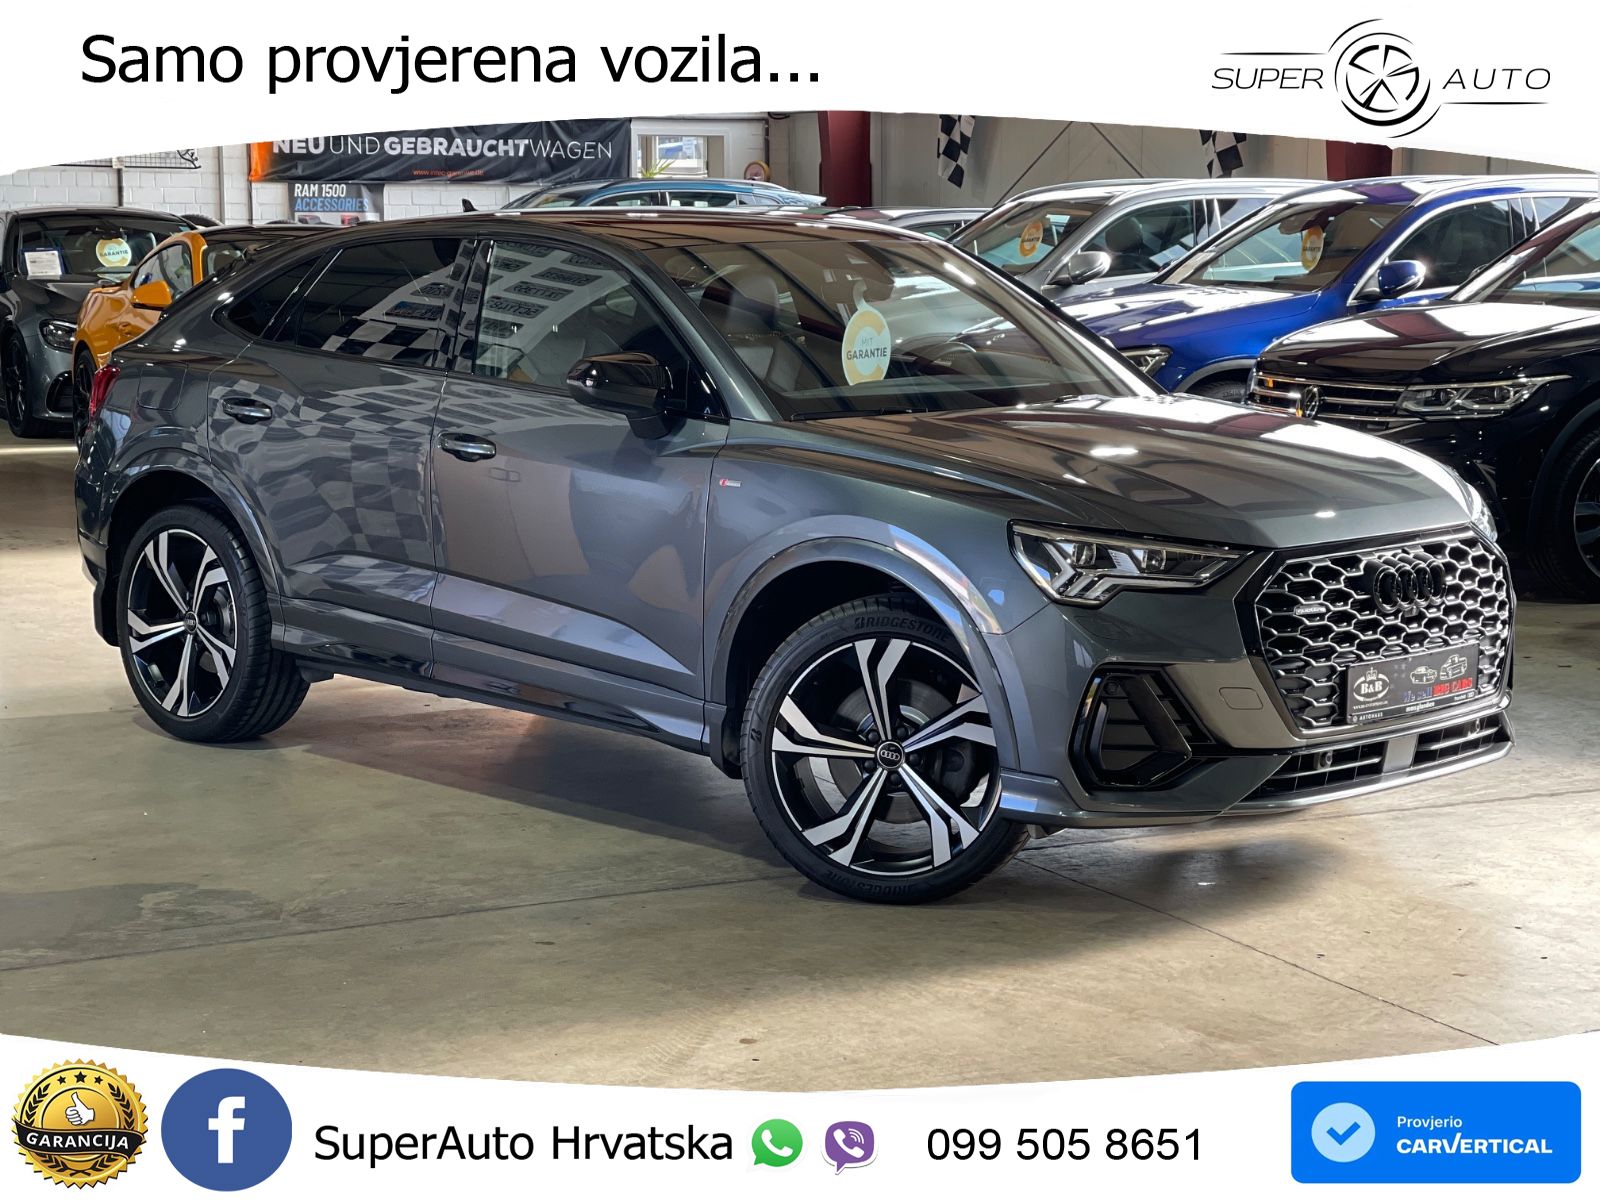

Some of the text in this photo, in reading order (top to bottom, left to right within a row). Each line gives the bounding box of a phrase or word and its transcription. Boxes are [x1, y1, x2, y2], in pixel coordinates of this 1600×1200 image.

[294, 183, 346, 197] RAM 1500
[295, 198, 369, 212] ACCESSORIES
[861, 336, 873, 348] MIT
[846, 346, 888, 361] GARANTIE
[854, 616, 949, 641] BRIDGESTONE
[1360, 680, 1382, 694] B&B
